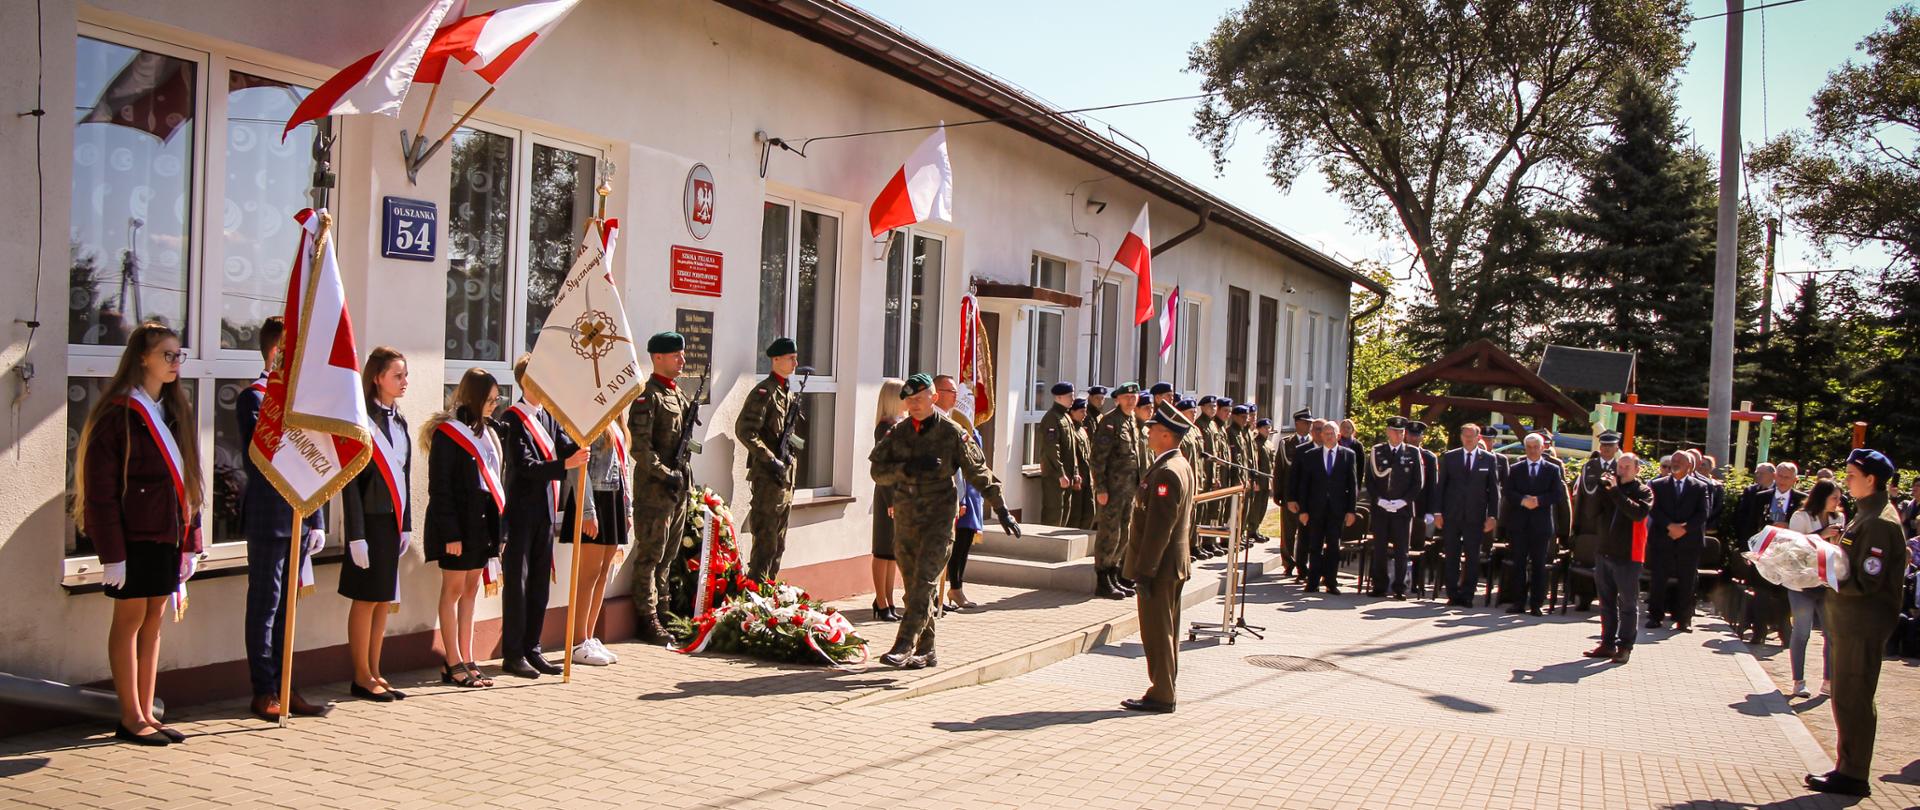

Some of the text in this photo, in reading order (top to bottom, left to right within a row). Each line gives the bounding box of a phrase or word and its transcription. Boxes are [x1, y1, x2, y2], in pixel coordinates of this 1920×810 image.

[393, 207, 435, 220] OLSZANKA
[396, 219, 431, 251] 54
[594, 361, 637, 406] W NOW
[257, 420, 286, 453] KACH
[284, 427, 332, 477] RBANOWICZA
